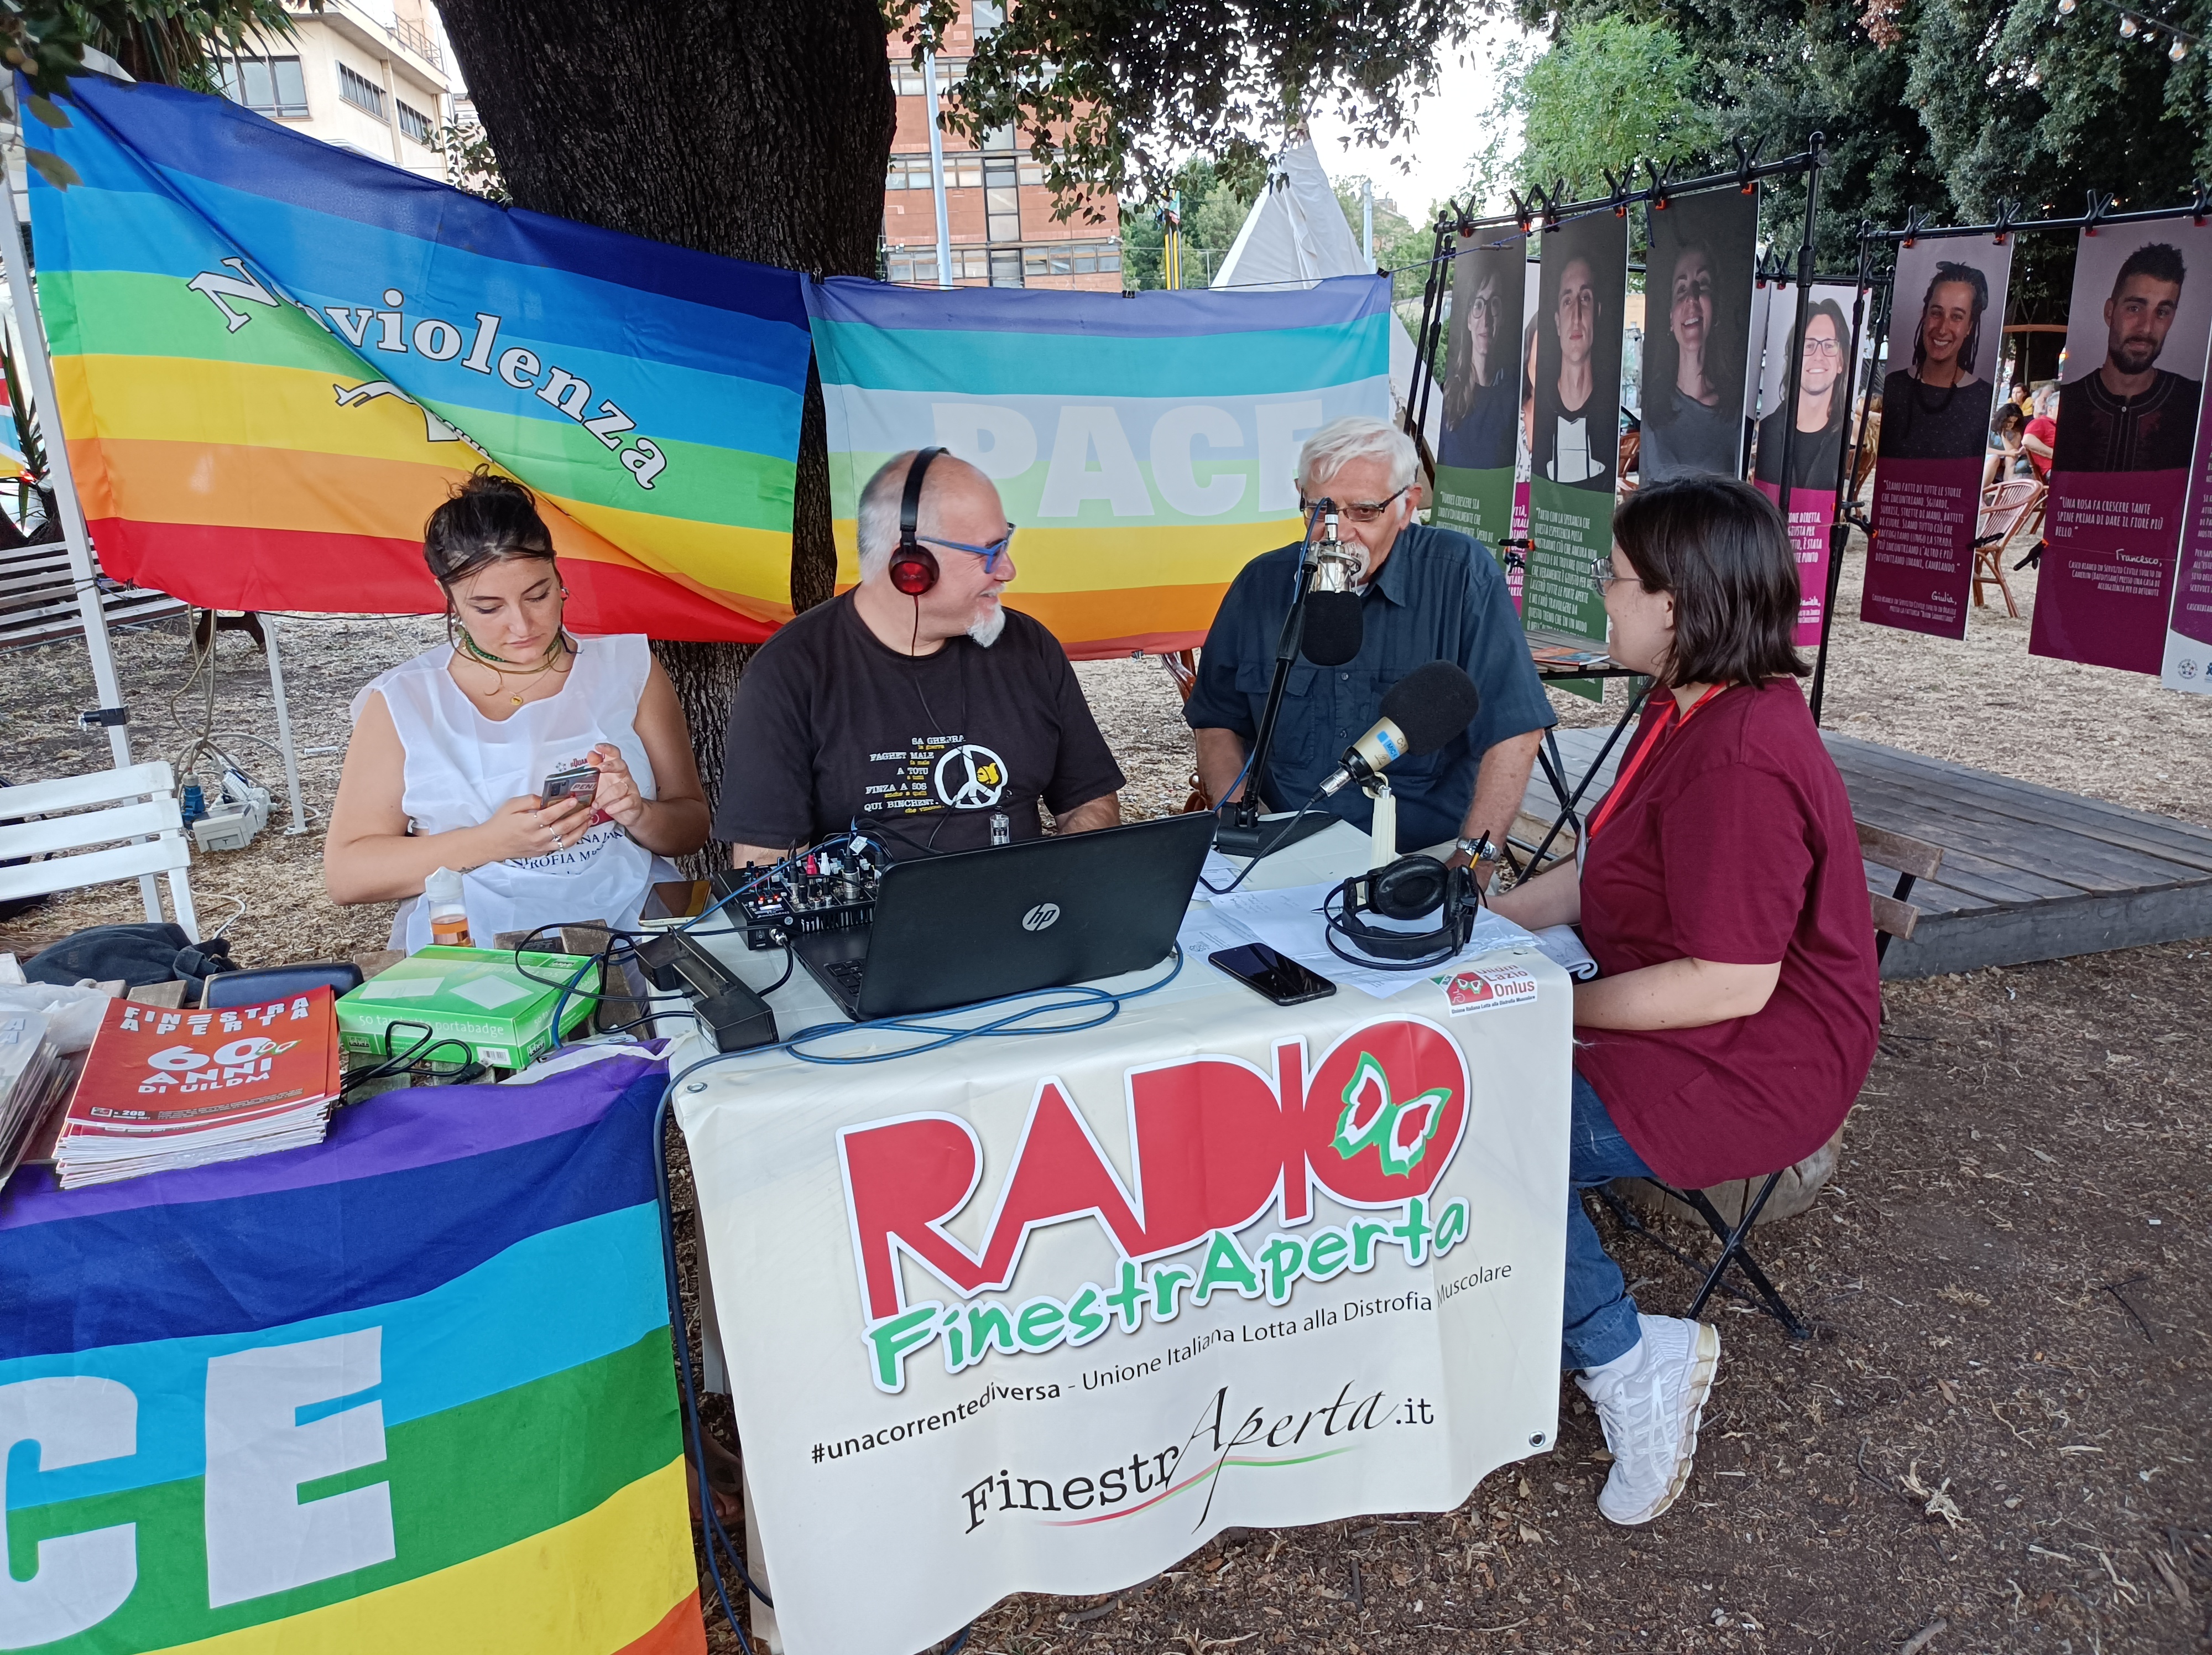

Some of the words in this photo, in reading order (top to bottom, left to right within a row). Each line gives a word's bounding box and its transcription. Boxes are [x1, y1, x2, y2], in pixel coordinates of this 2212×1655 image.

[186, 257, 667, 490] Nviolenza
[1902, 482, 1915, 492] FATTI
[1916, 483, 1922, 493] DI
[1924, 485, 1937, 495] TUTTE
[1938, 486, 1943, 496] LE
[1944, 486, 1961, 497] STORIE
[1901, 507, 1918, 518] STRETTE
[1919, 509, 1924, 518] DI
[1943, 512, 1963, 523] BATTITI
[2077, 498, 2091, 509] ROSA
[2093, 499, 2100, 510] FA
[2101, 500, 2129, 513] CRESCERE
[2131, 502, 2151, 515] TANTE
[1558, 512, 1563, 523] LA
[1879, 516, 1885, 525] DI
[1902, 518, 1917, 530] SIAMO
[1944, 524, 1953, 534] CHE
[2057, 511, 2074, 522] SPINE
[2075, 512, 2095, 524] PRIMA
[2096, 514, 2104, 525] DI
[2105, 514, 2120, 527] DARE
[2122, 516, 2128, 528] IL
[2130, 517, 2149, 529] FIORE
[2150, 517, 2163, 530] PIÙ
[1807, 538, 1822, 549] STATA
[1926, 534, 1933, 545] LA
[1801, 551, 1818, 563] PUNTO
[2116, 548, 2162, 567] Francesco,
[1932, 591, 1957, 605] Giulia,
[864, 802, 883, 811] QUI
[1024, 903, 1058, 931] hp
[1484, 970, 1528, 981] Lazio
[1494, 981, 1535, 997] Onlus
[124, 997, 309, 1024] FINESTRA
[120, 1007, 309, 1035] APERTA
[359, 1016, 373, 1026] 50
[435, 1022, 504, 1038] portabadge
[148, 1037, 272, 1070] 60
[142, 1057, 272, 1085] ANNI
[138, 1085, 166, 1093] DI
[180, 1072, 270, 1092] UILDM
[844, 1020, 1465, 1319] RADIO
[871, 1198, 1464, 1386] FinestrAperta
[811, 1380, 1062, 1465] #unacorrentediversa
[1082, 1355, 1162, 1392] Unione
[1167, 1326, 1235, 1371] Italiana
[1242, 1320, 1298, 1343] Lotta
[1302, 1309, 1338, 1332] alla
[1344, 1290, 1432, 1323] Distrofia
[1436, 1262, 1512, 1308] Muscolare
[962, 1378, 1434, 1536] FinestrAperta.it
